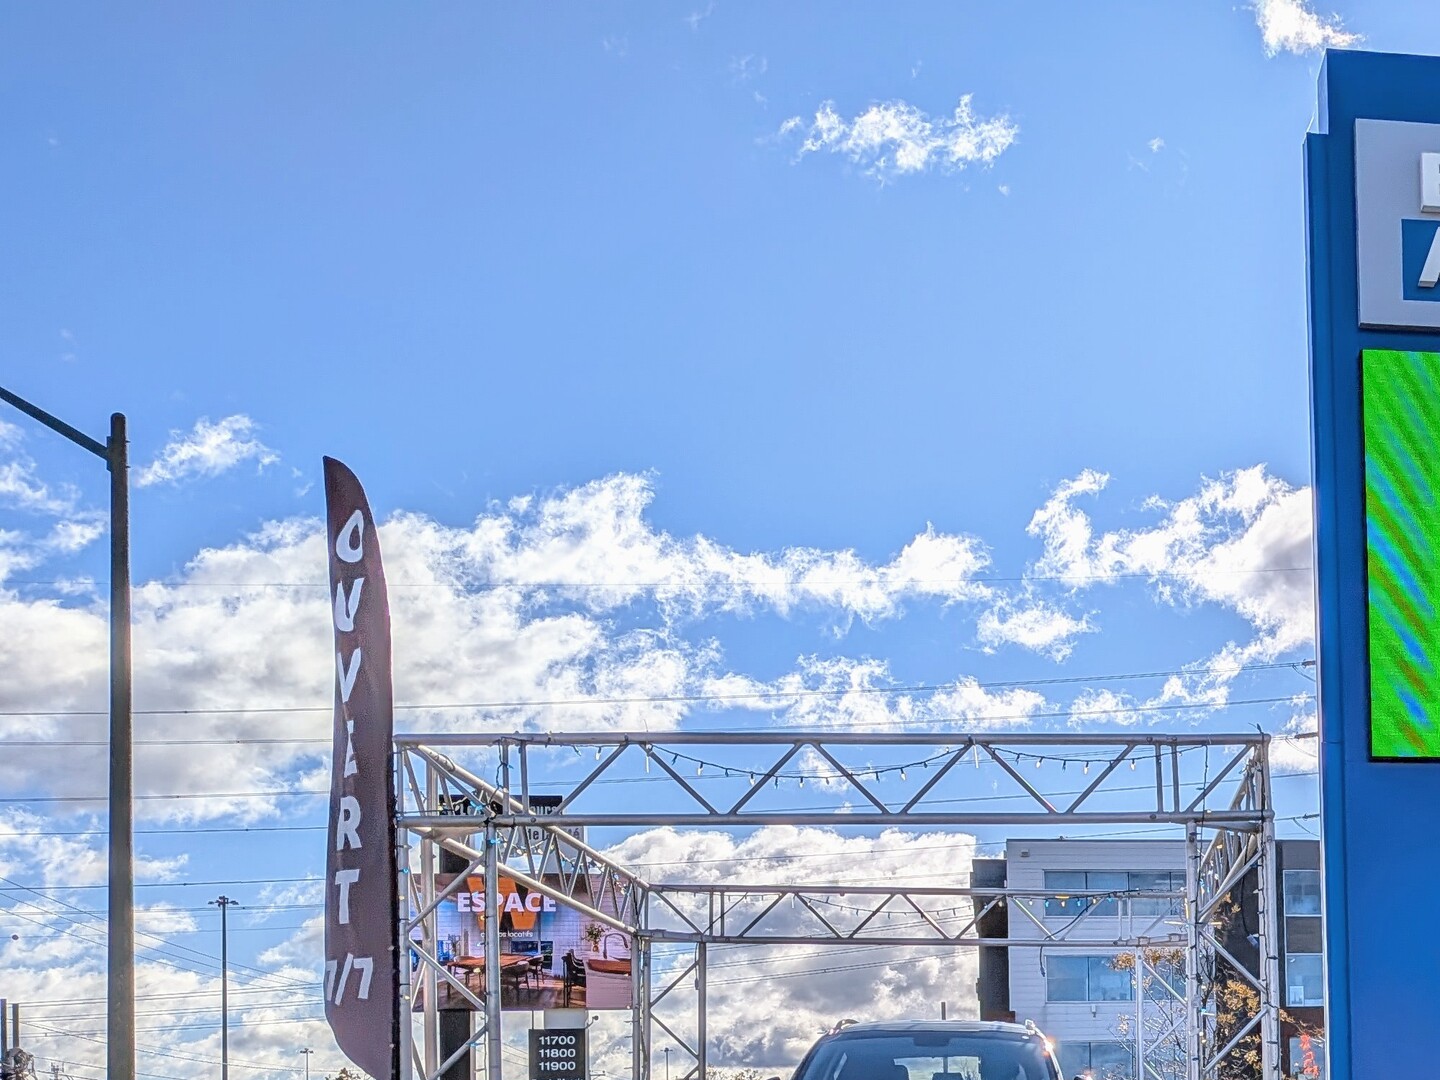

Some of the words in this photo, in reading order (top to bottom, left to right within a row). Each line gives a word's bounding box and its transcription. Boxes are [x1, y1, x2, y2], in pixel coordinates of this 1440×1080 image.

[508, 930, 533, 938] locatifs
[539, 1036, 576, 1045] 11700
[539, 1049, 576, 1058] 11800
[539, 1061, 576, 1071] 11900
